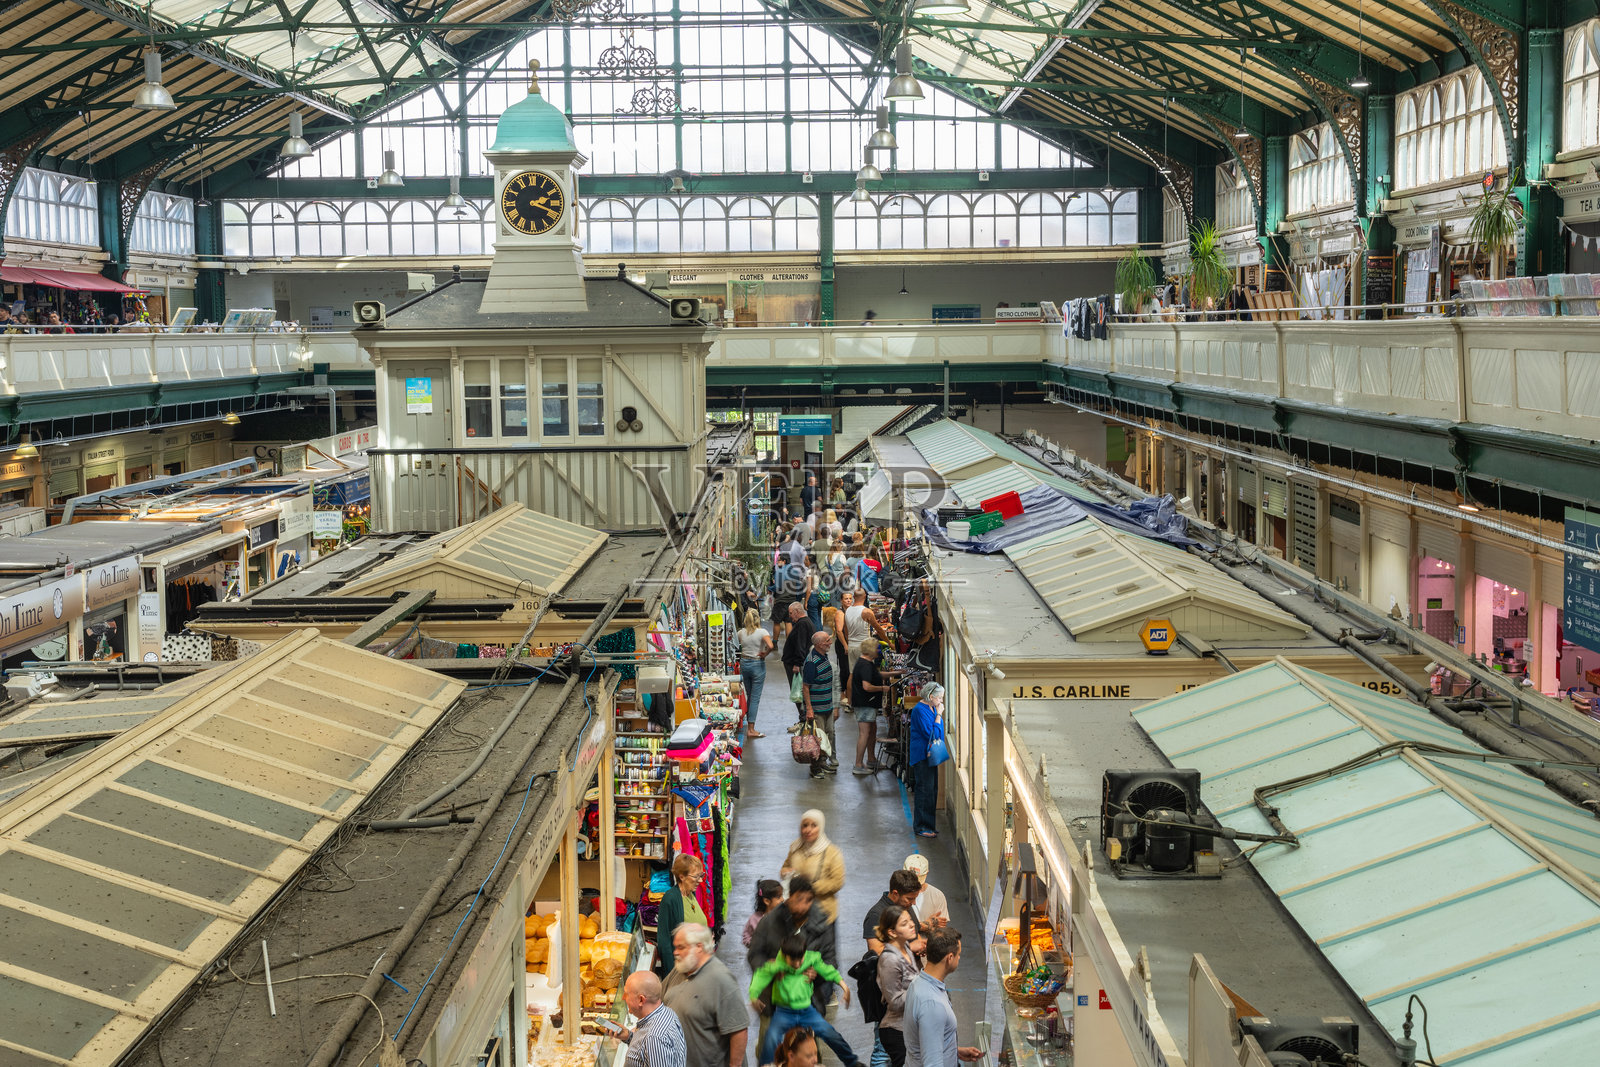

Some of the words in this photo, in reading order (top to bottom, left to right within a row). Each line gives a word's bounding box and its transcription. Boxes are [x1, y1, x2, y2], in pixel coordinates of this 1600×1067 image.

[1580, 199, 1593, 213] TEA
[1404, 226, 1416, 238] COOK
[1416, 224, 1430, 236] DINNER
[100, 568, 110, 586] On
[112, 565, 129, 582] Time
[522, 602, 539, 610] 160
[13, 603, 42, 630] Time
[1150, 630, 1167, 640] ADT
[1012, 686, 1027, 698] J.
[1032, 686, 1046, 698] S.
[1053, 686, 1130, 698] CARLINE
